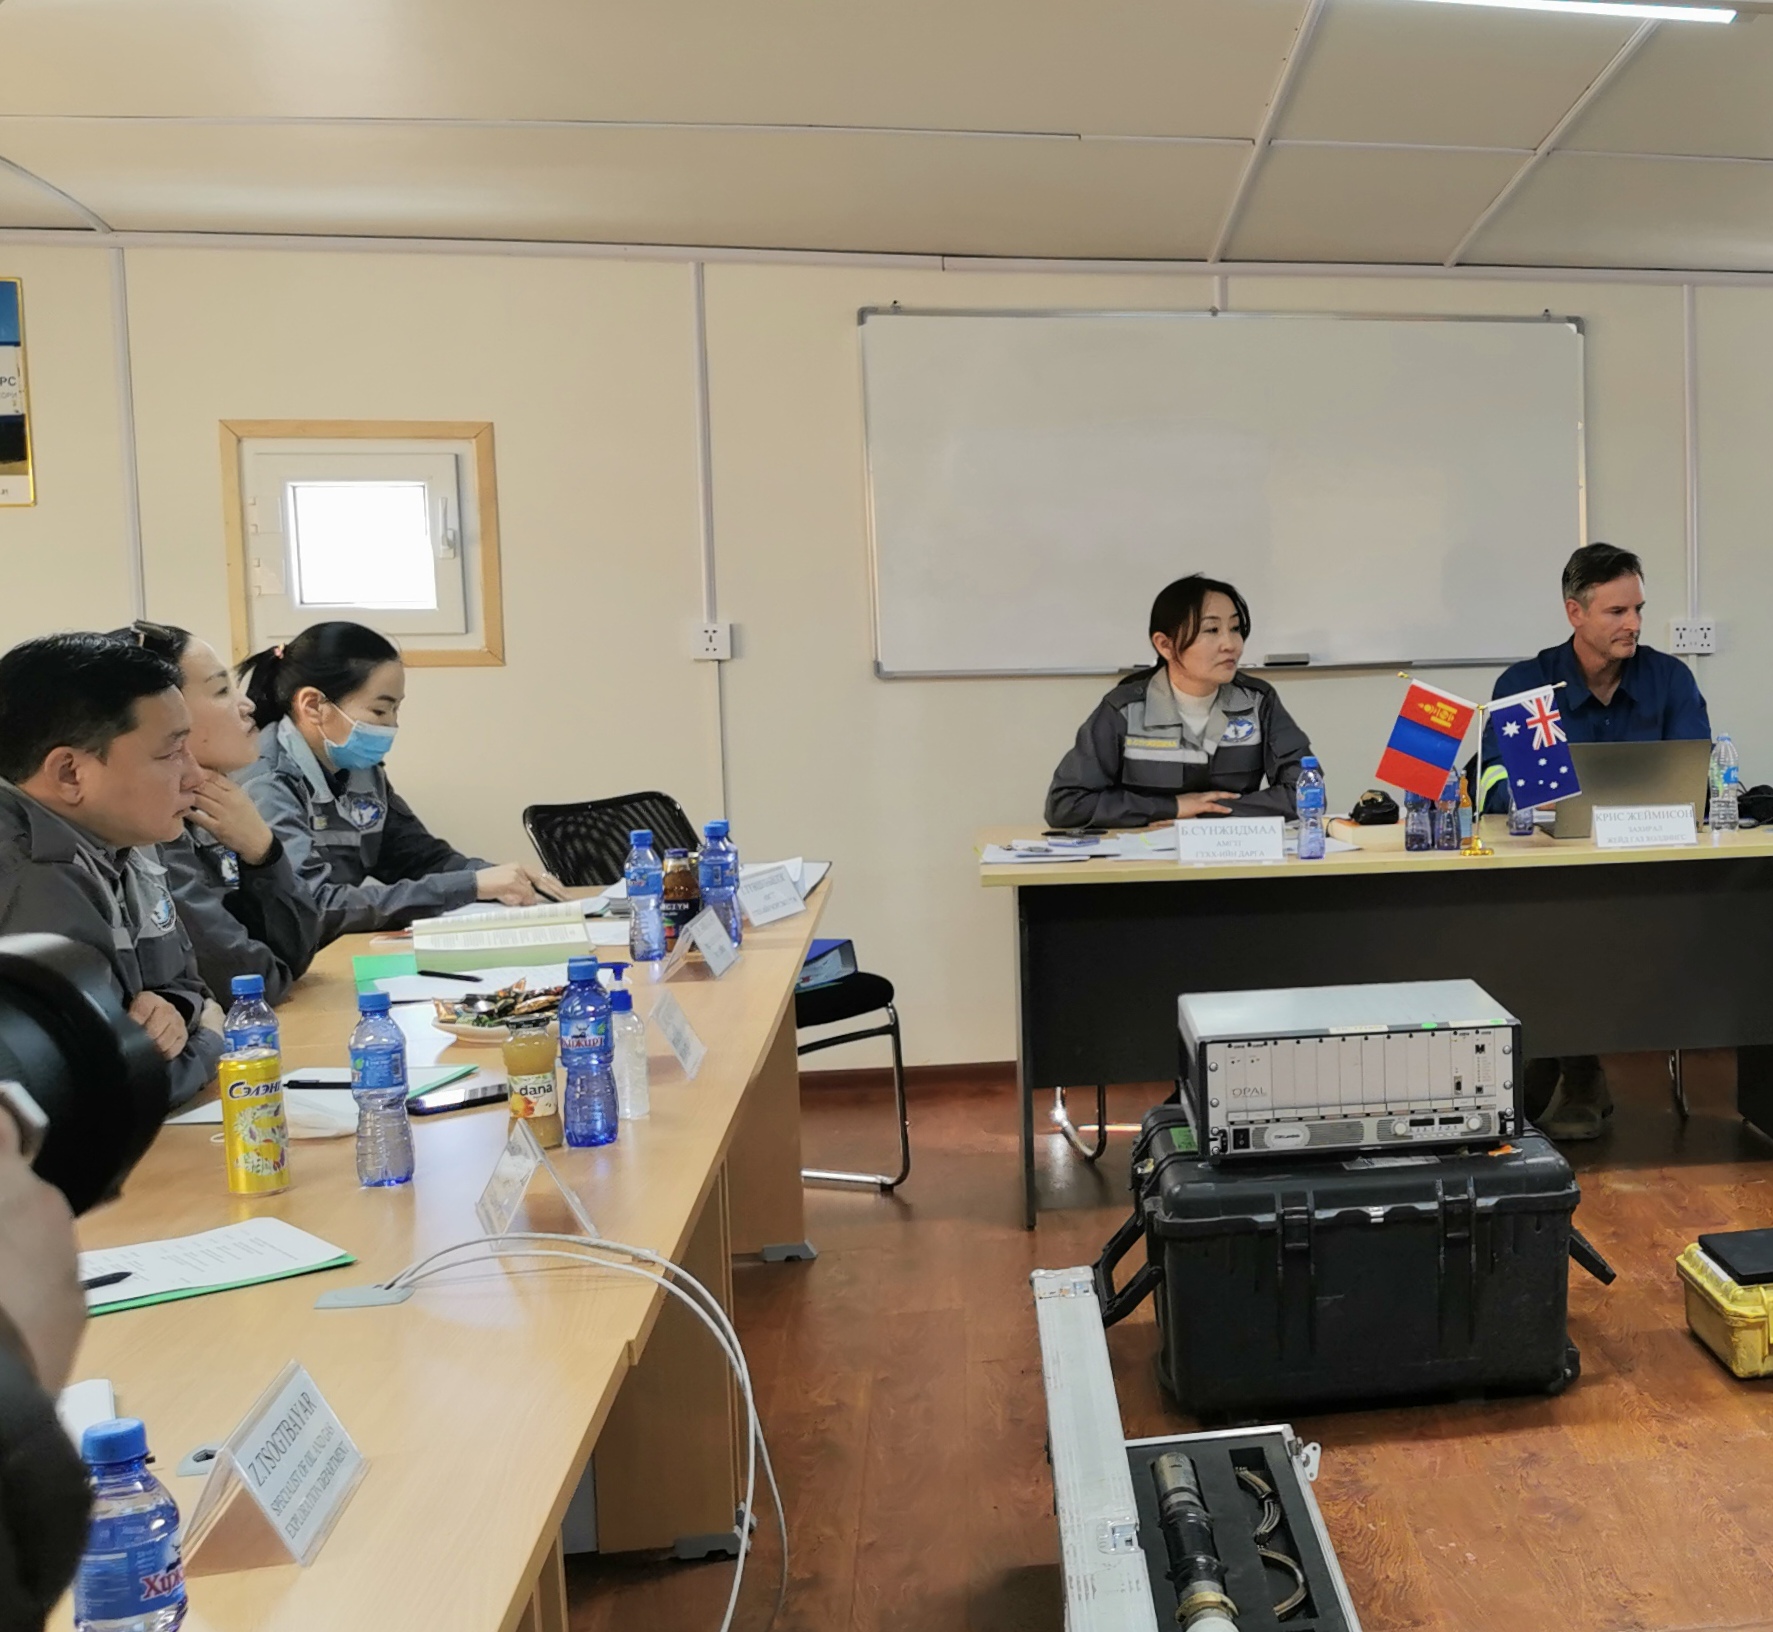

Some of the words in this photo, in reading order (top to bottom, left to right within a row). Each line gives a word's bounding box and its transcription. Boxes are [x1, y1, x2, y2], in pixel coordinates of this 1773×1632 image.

[1596, 811, 1625, 822] КРИС
[1627, 804, 1694, 821] ЖЕЙМИСОН
[519, 1083, 553, 1097] dana
[1231, 1087, 1268, 1099] OPAL
[248, 1391, 318, 1488] Z.TSOGTBAYAR
[270, 1468, 304, 1517] SPECIALIST
[284, 1487, 322, 1540] EXPLORATION
[320, 1440, 350, 1492] DEPARTMENT
